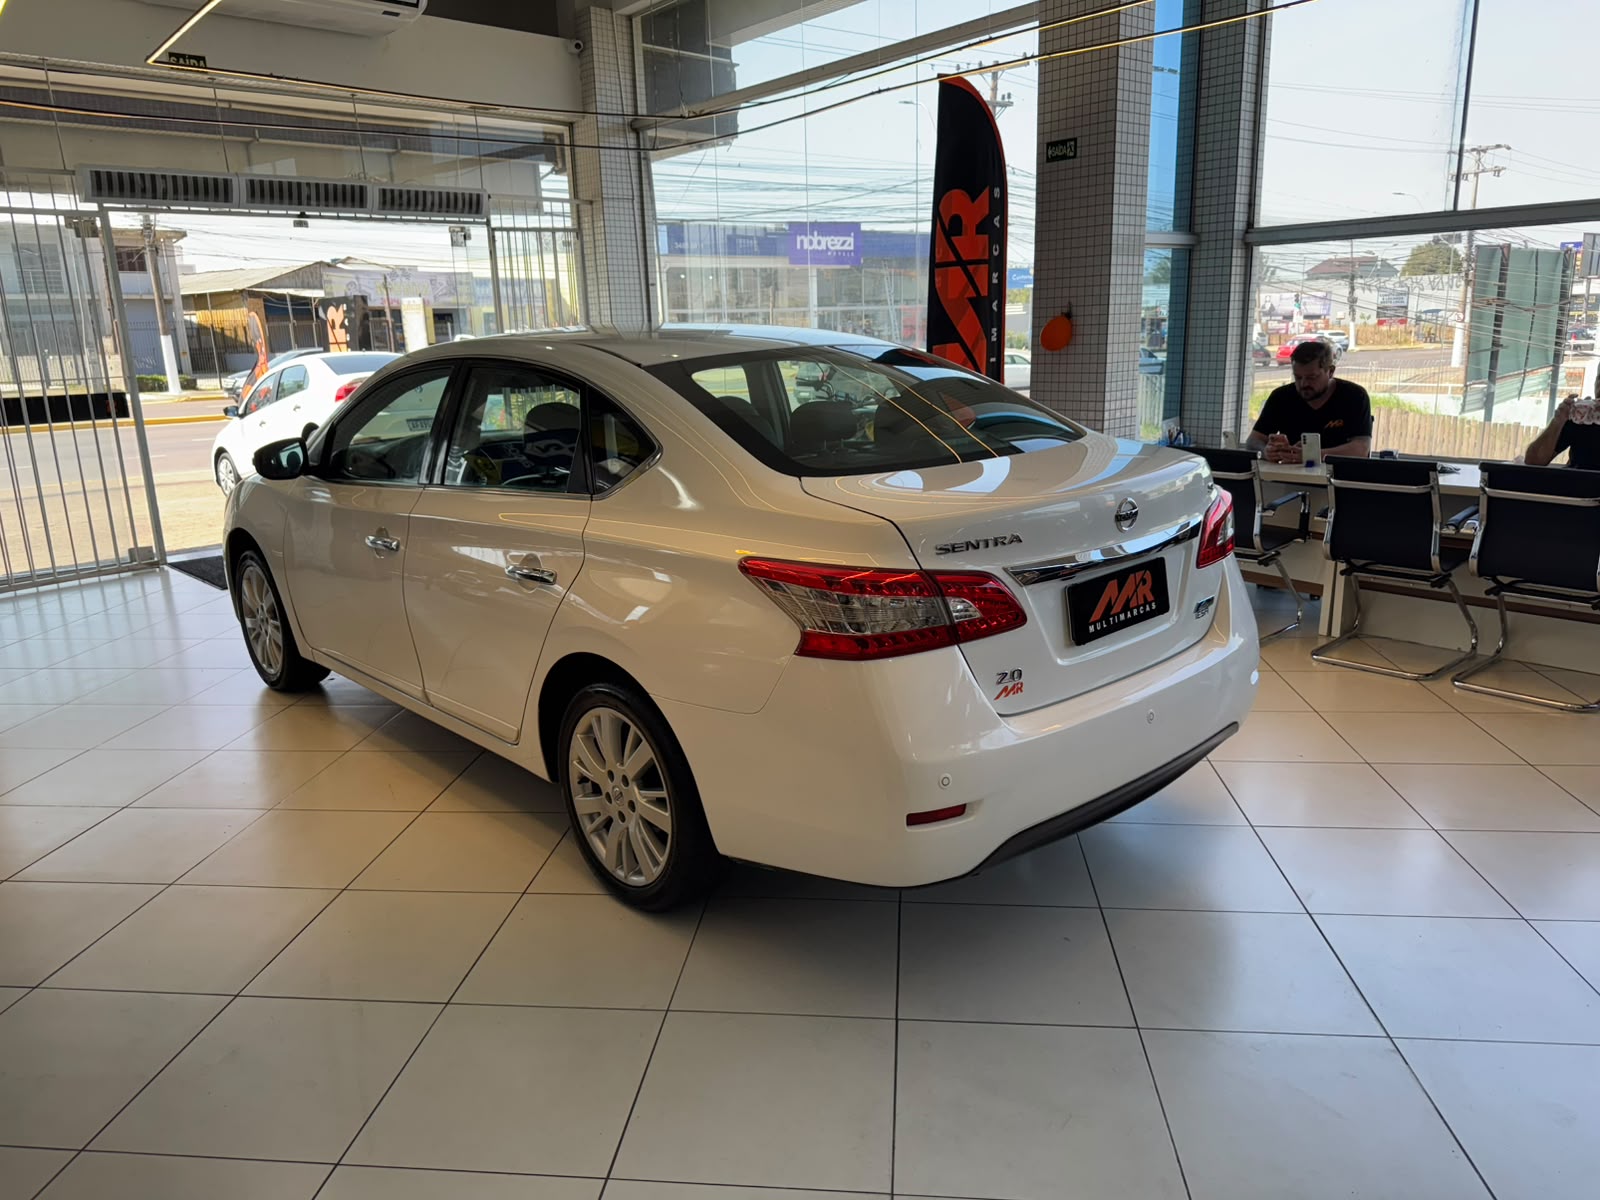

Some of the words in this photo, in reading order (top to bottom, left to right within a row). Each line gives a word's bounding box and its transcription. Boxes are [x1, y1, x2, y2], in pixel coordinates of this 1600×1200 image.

[796, 230, 854, 250] nobrezzi
[934, 533, 1023, 556] SENTRA
[1088, 602, 1157, 634] MULTIMARCAS
